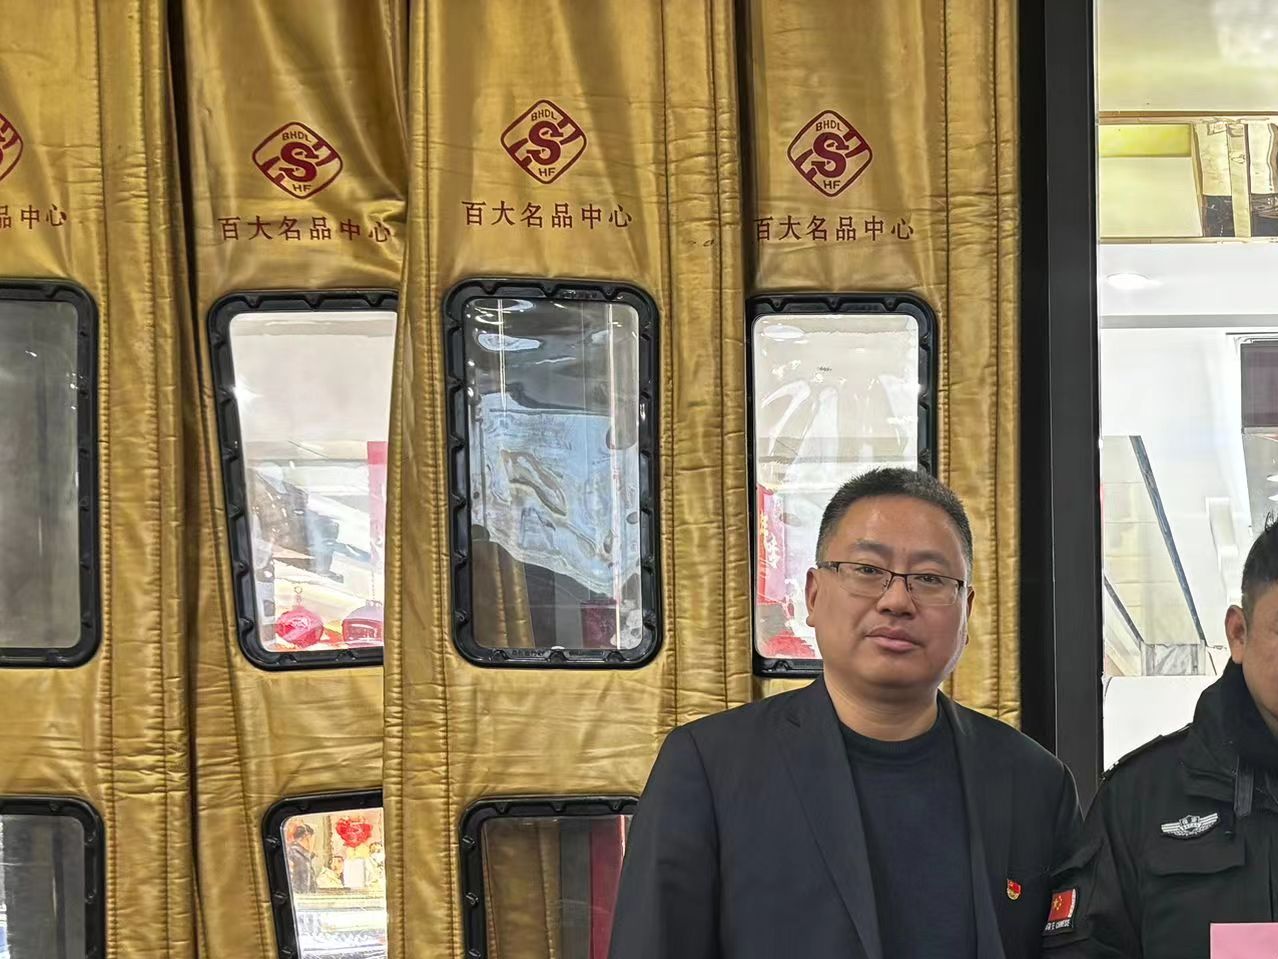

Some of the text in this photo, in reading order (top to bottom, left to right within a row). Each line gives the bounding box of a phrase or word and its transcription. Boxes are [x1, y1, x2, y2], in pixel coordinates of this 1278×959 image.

[530, 109, 558, 121] BHDL
[815, 119, 843, 132] BHDL
[281, 130, 312, 143] BHDL
[538, 167, 556, 177] HF
[292, 183, 312, 193] HF
[822, 180, 841, 190] HF
[461, 200, 632, 230] 百大名品中心
[217, 215, 392, 242] 百大名品中心
[753, 214, 914, 242] 百大名品中心
